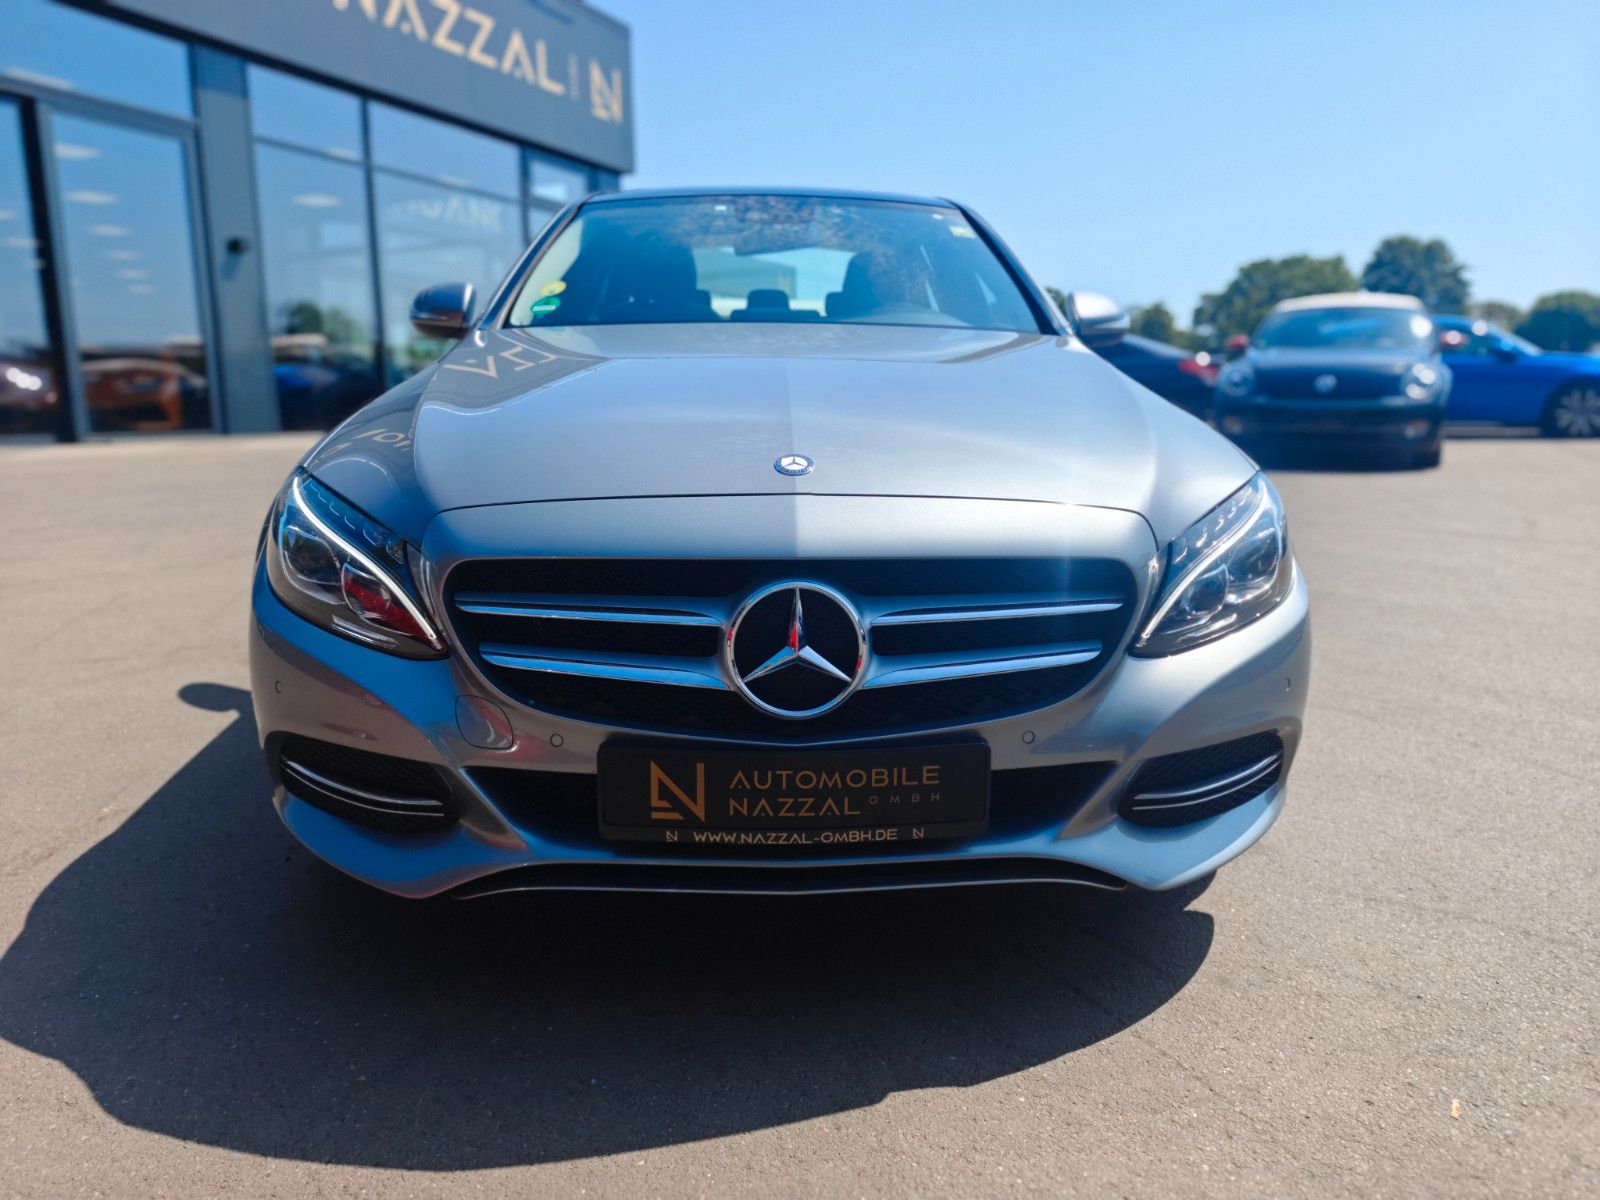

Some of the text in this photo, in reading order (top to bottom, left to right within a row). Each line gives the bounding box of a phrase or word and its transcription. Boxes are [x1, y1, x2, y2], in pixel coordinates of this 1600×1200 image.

[728, 764, 941, 791] AUTOMOBILE
[728, 797, 861, 818] NAZZAL
[693, 828, 899, 845] WWW.NAZZAL-GMBH.DE
